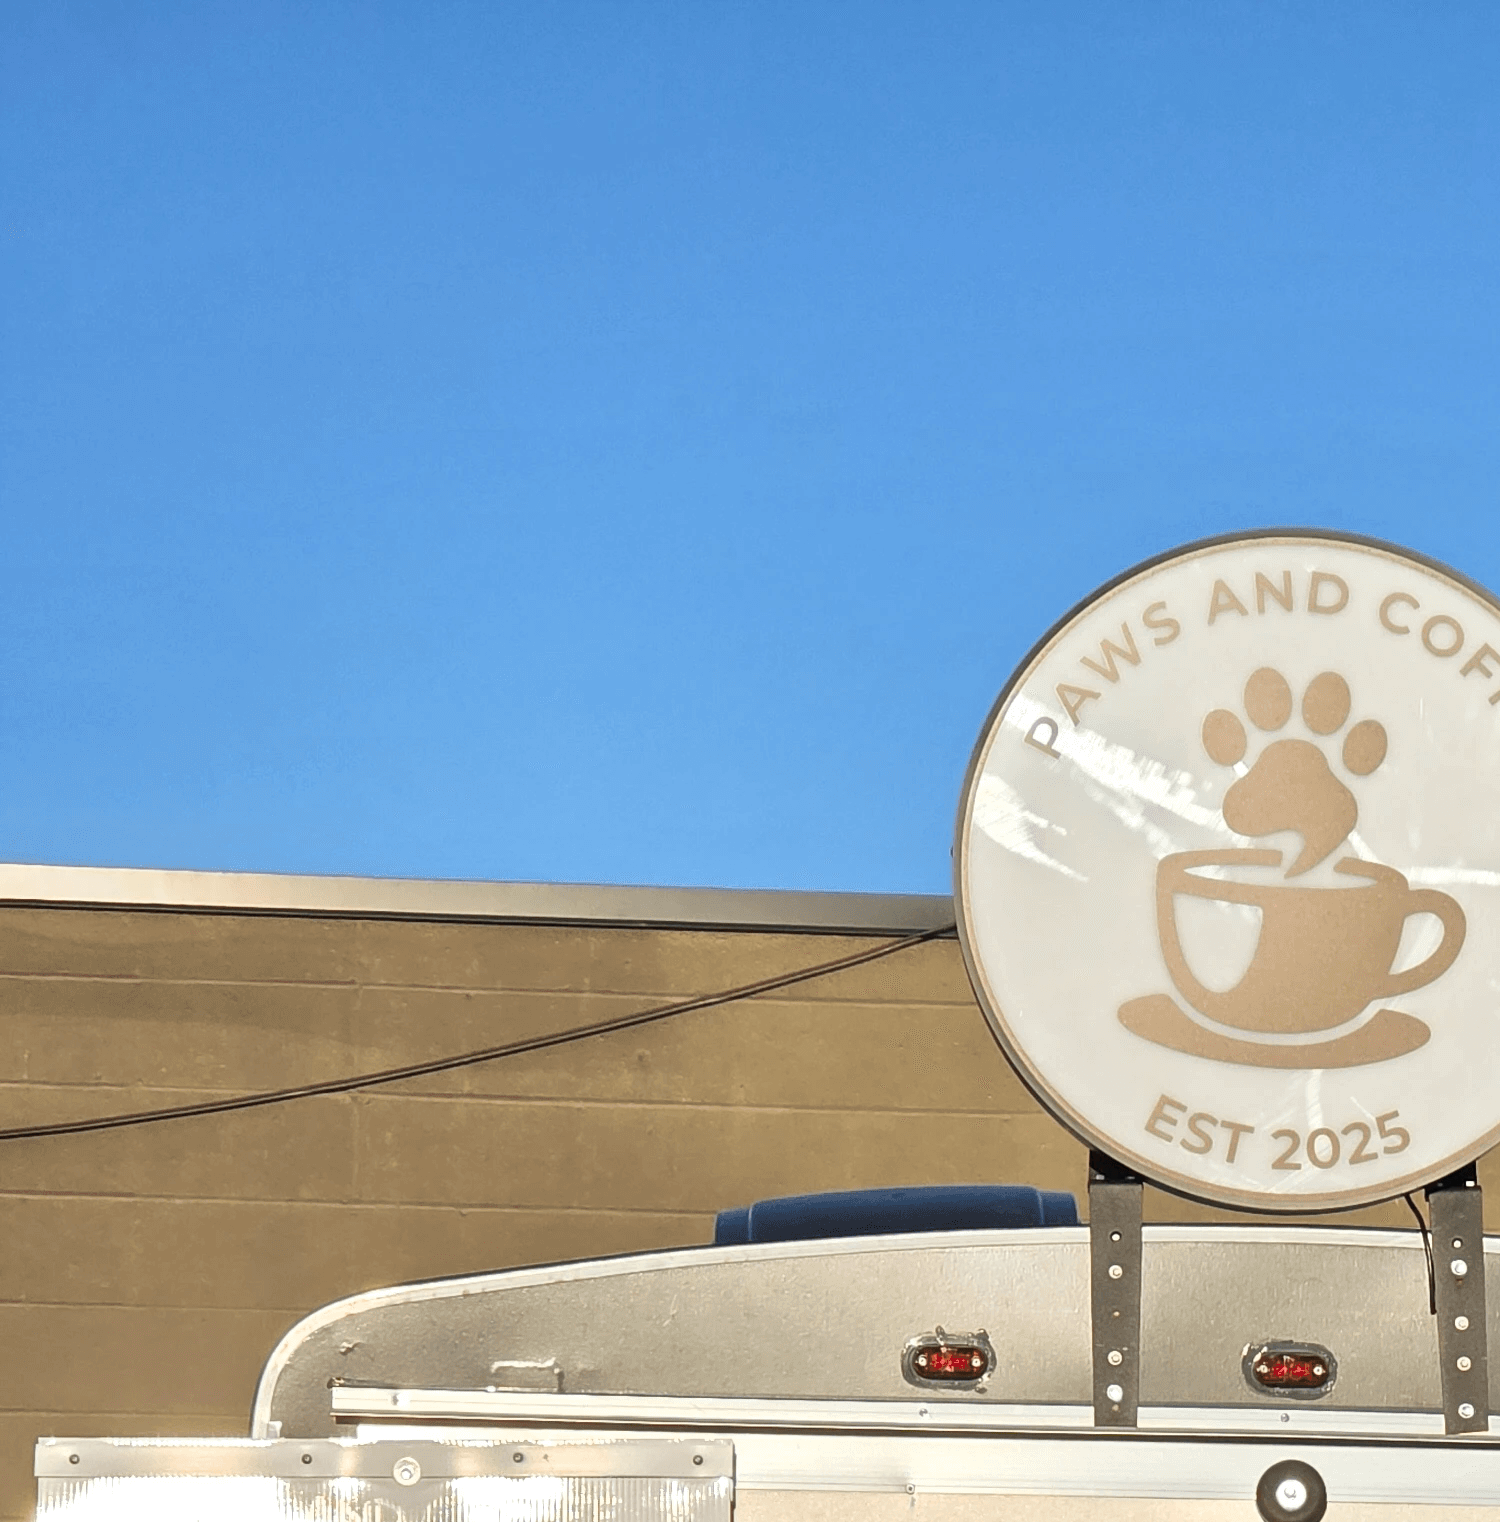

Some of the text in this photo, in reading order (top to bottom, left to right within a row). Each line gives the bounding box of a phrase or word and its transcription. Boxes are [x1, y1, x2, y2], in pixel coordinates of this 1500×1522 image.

[1023, 600, 1182, 759] PAWS
[1207, 570, 1350, 626] AND
[1143, 1094, 1412, 1171] EST 2025
